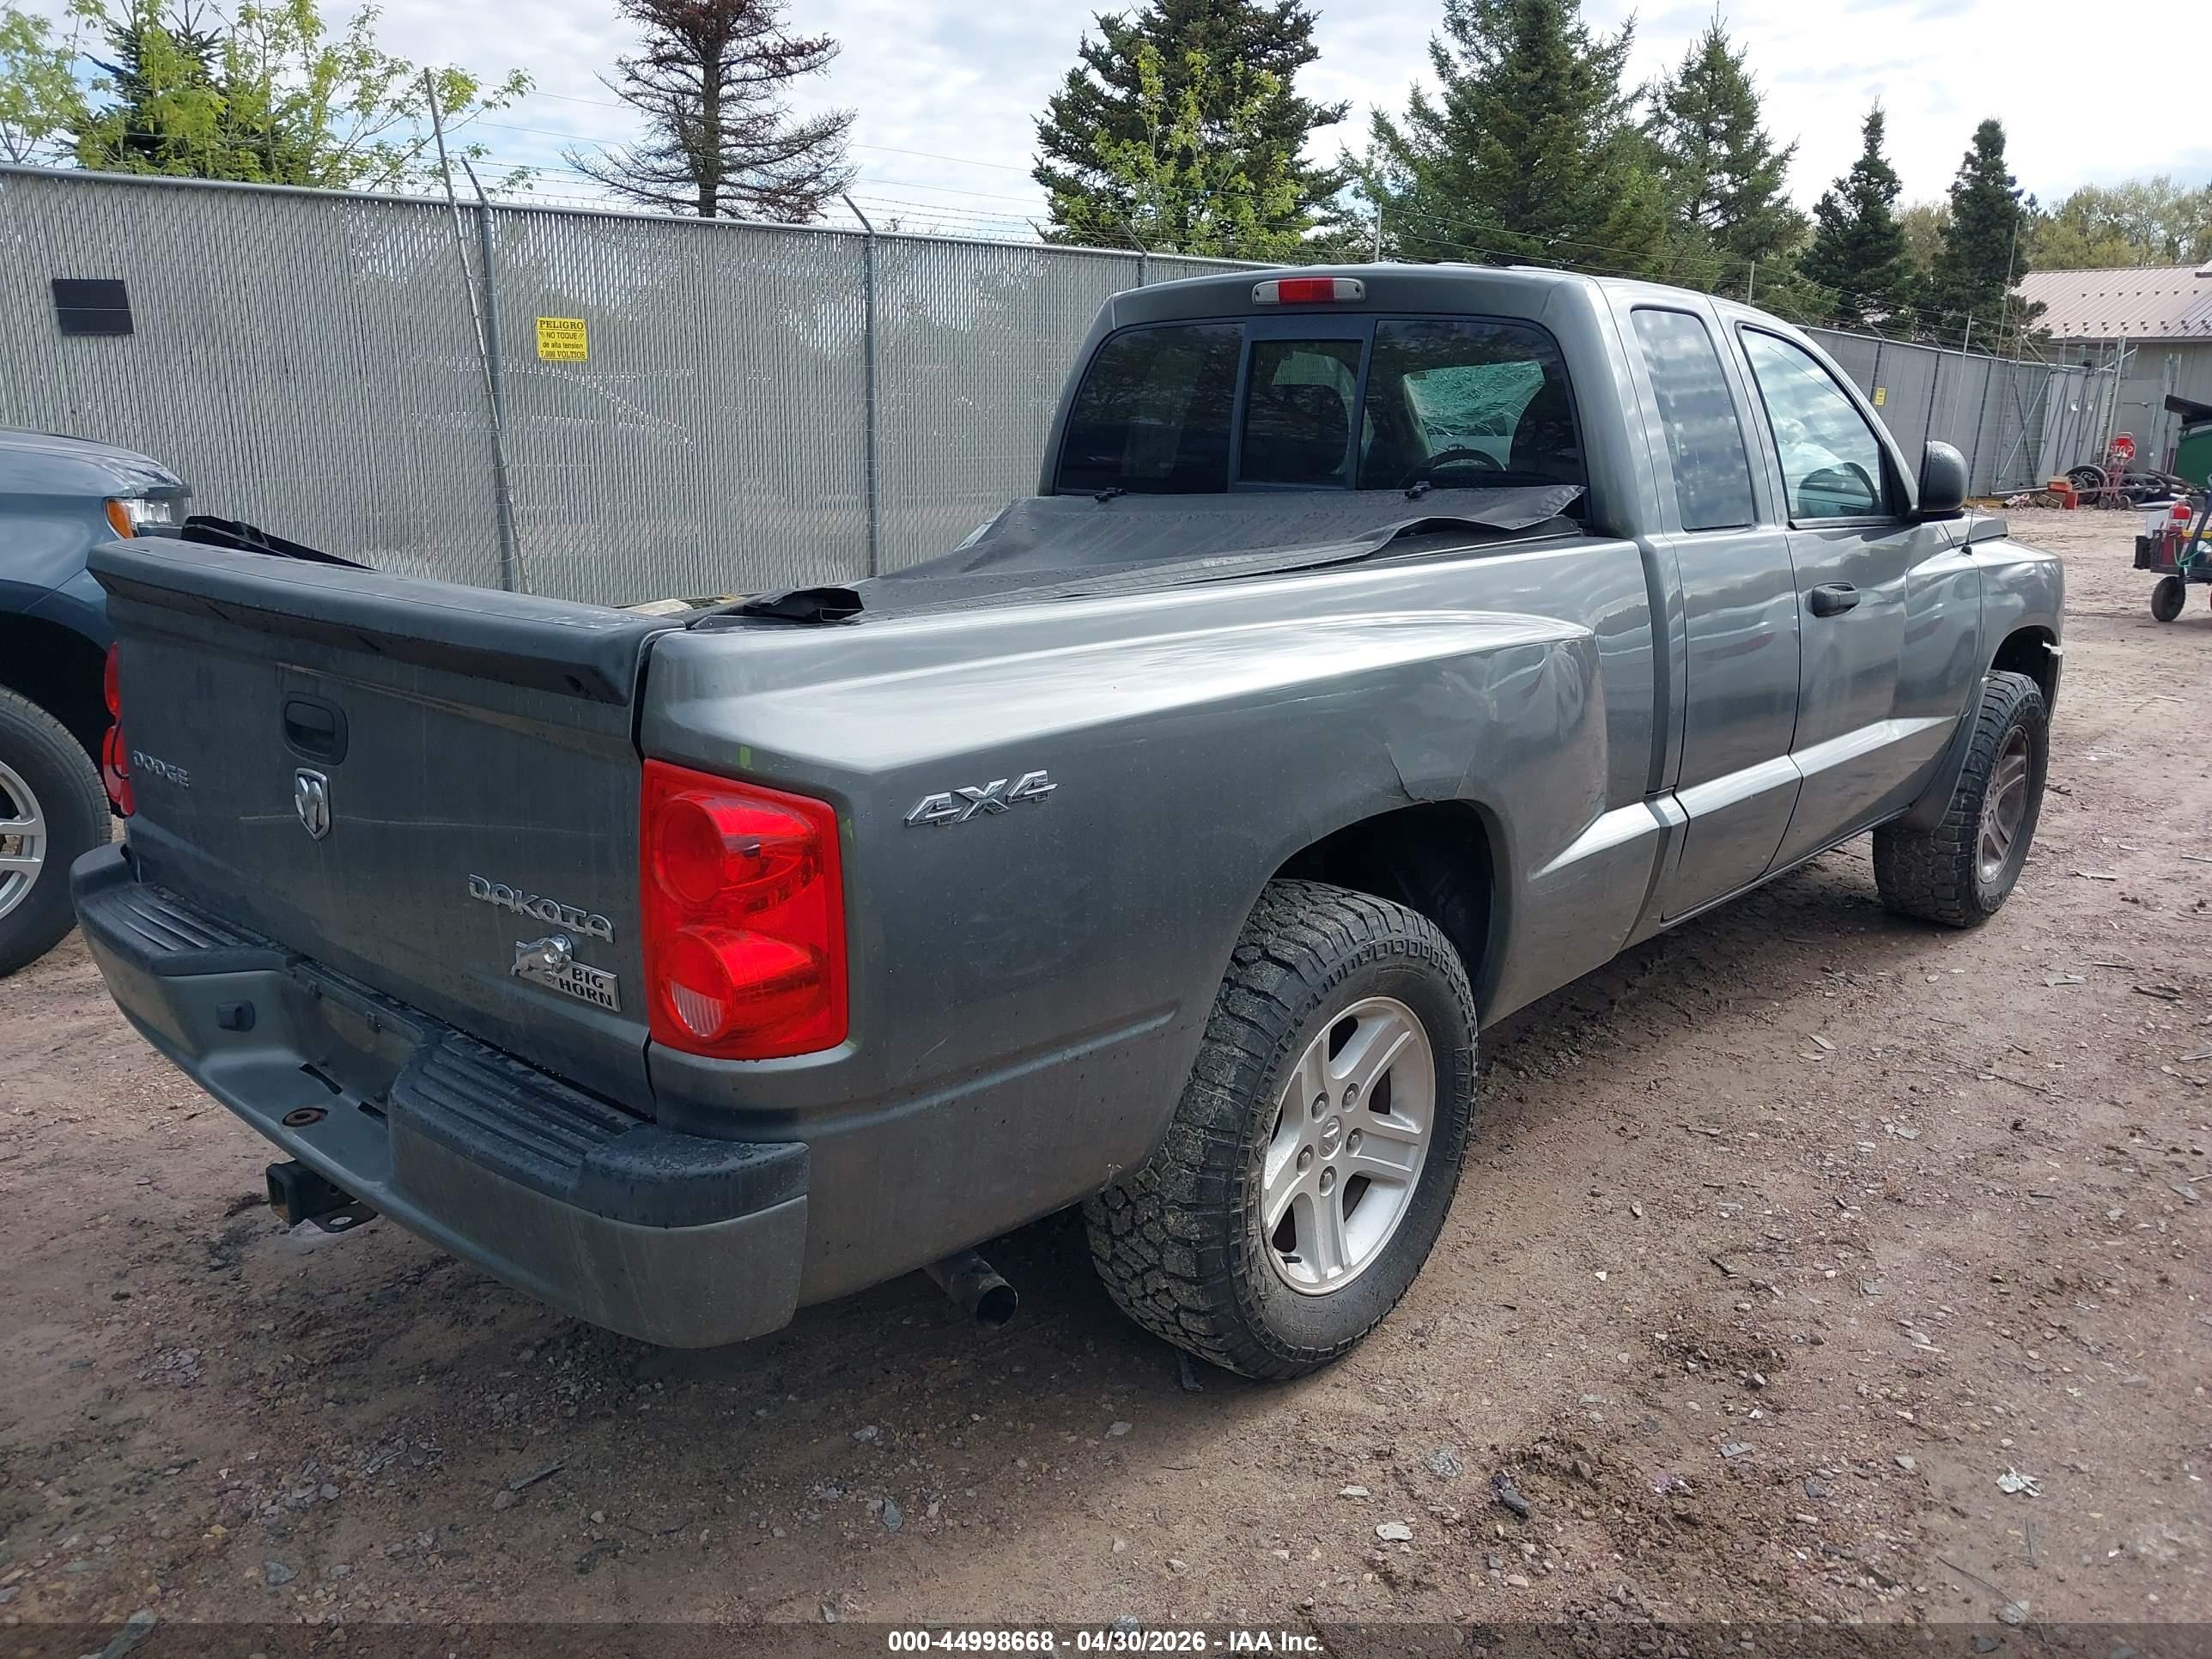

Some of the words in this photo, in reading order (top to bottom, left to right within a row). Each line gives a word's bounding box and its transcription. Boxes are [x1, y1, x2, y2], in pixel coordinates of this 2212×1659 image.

[539, 320, 583, 330] PELIGRO
[132, 750, 190, 788] DODGE
[468, 873, 615, 944] DAKOTA
[559, 978, 612, 1006] HORN
[571, 968, 604, 988] BIG
